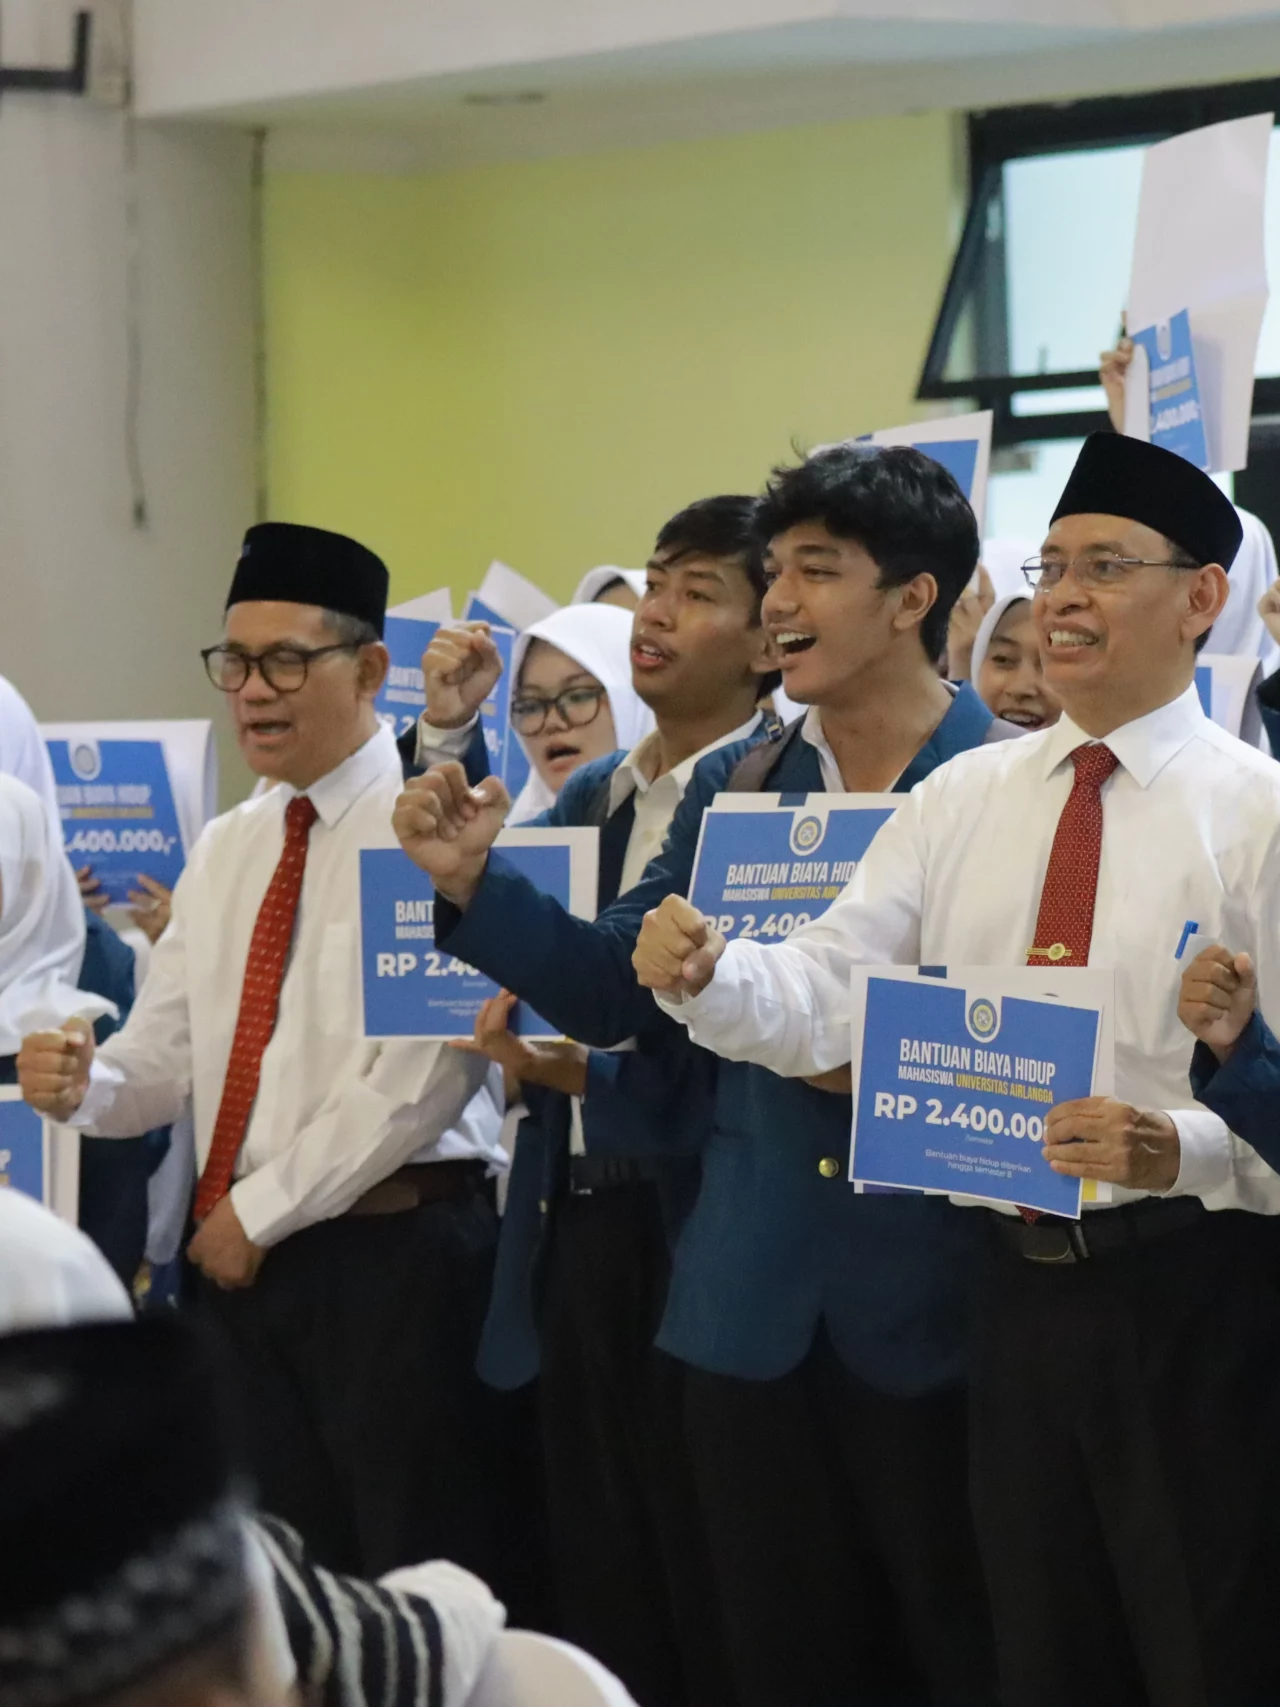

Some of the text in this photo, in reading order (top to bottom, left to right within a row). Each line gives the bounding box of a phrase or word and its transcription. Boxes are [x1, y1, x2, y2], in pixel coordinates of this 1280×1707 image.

[726, 861, 858, 885] BANTUAN BIAYA HID
[771, 886, 820, 900] UNIVERSITAS
[395, 900, 435, 923] BANT
[376, 952, 417, 977] RP
[900, 1038, 1056, 1086] BANTUAN BIAYA HIDUP
[898, 1065, 1054, 1104] MAHASISWA UNIVERSITAS AIRLANGGA
[874, 1092, 1048, 1142] RP 2.400.00
[925, 1149, 958, 1161] Bantuan
[979, 1156, 1000, 1169] hidup
[948, 1161, 974, 1173] hingga
[974, 1166, 1006, 1178] semester
